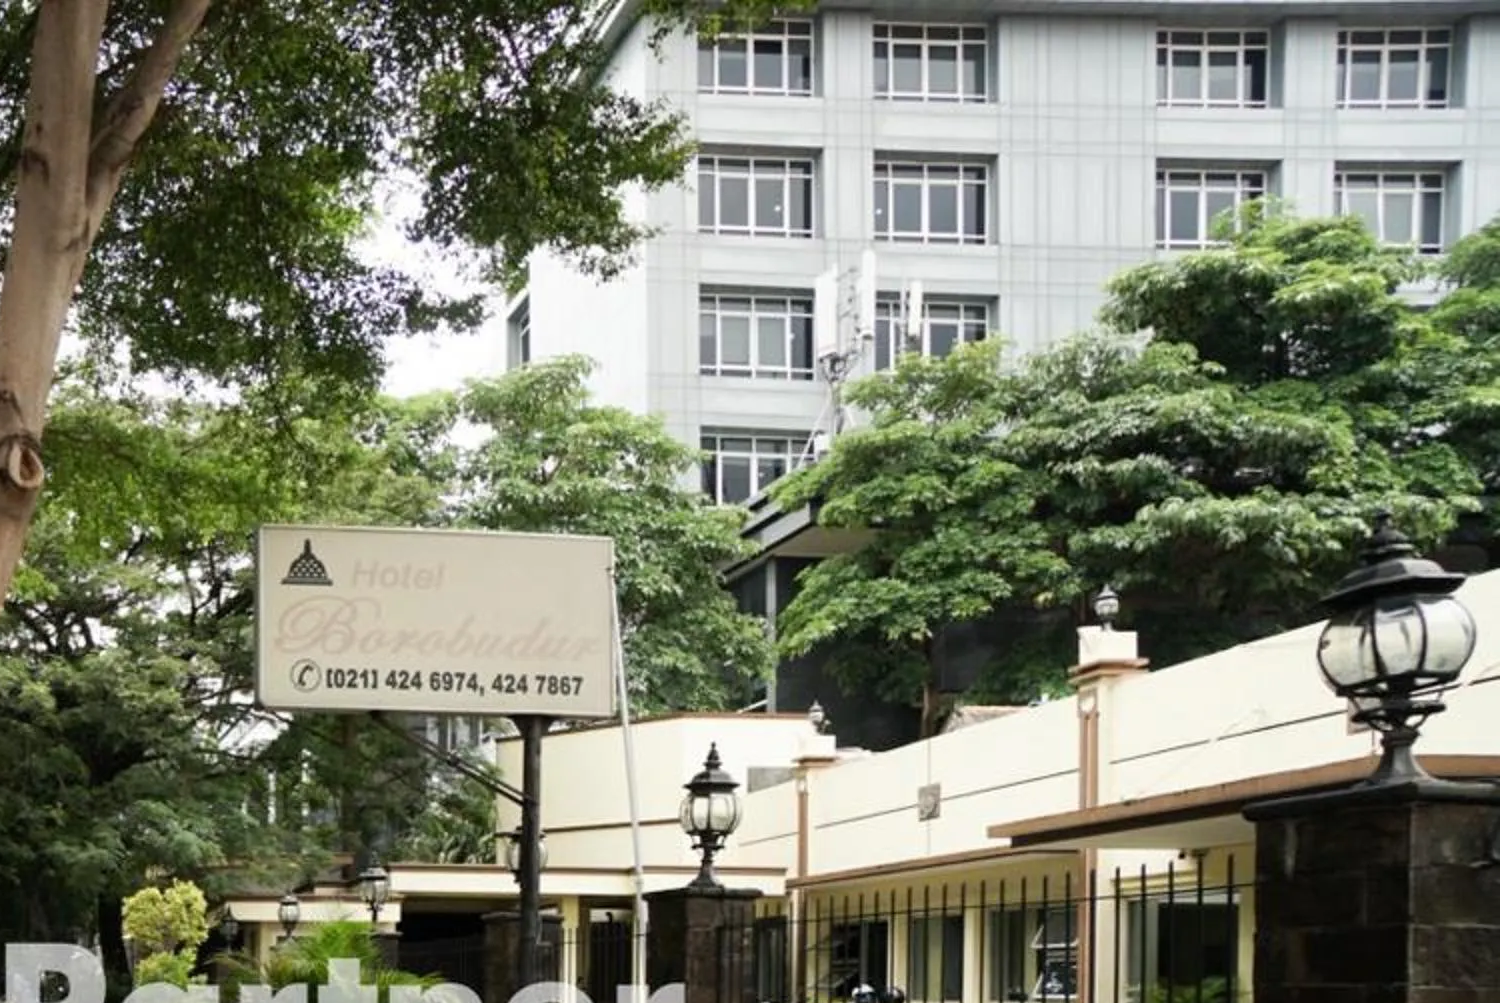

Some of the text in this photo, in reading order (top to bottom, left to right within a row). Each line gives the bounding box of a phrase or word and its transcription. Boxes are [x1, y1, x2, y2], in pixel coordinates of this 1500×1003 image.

[352, 560, 447, 591] Hotel
[385, 670, 423, 691] 424
[429, 671, 485, 697] 6974,
[491, 674, 528, 694] 424
[535, 676, 584, 696] 7867
